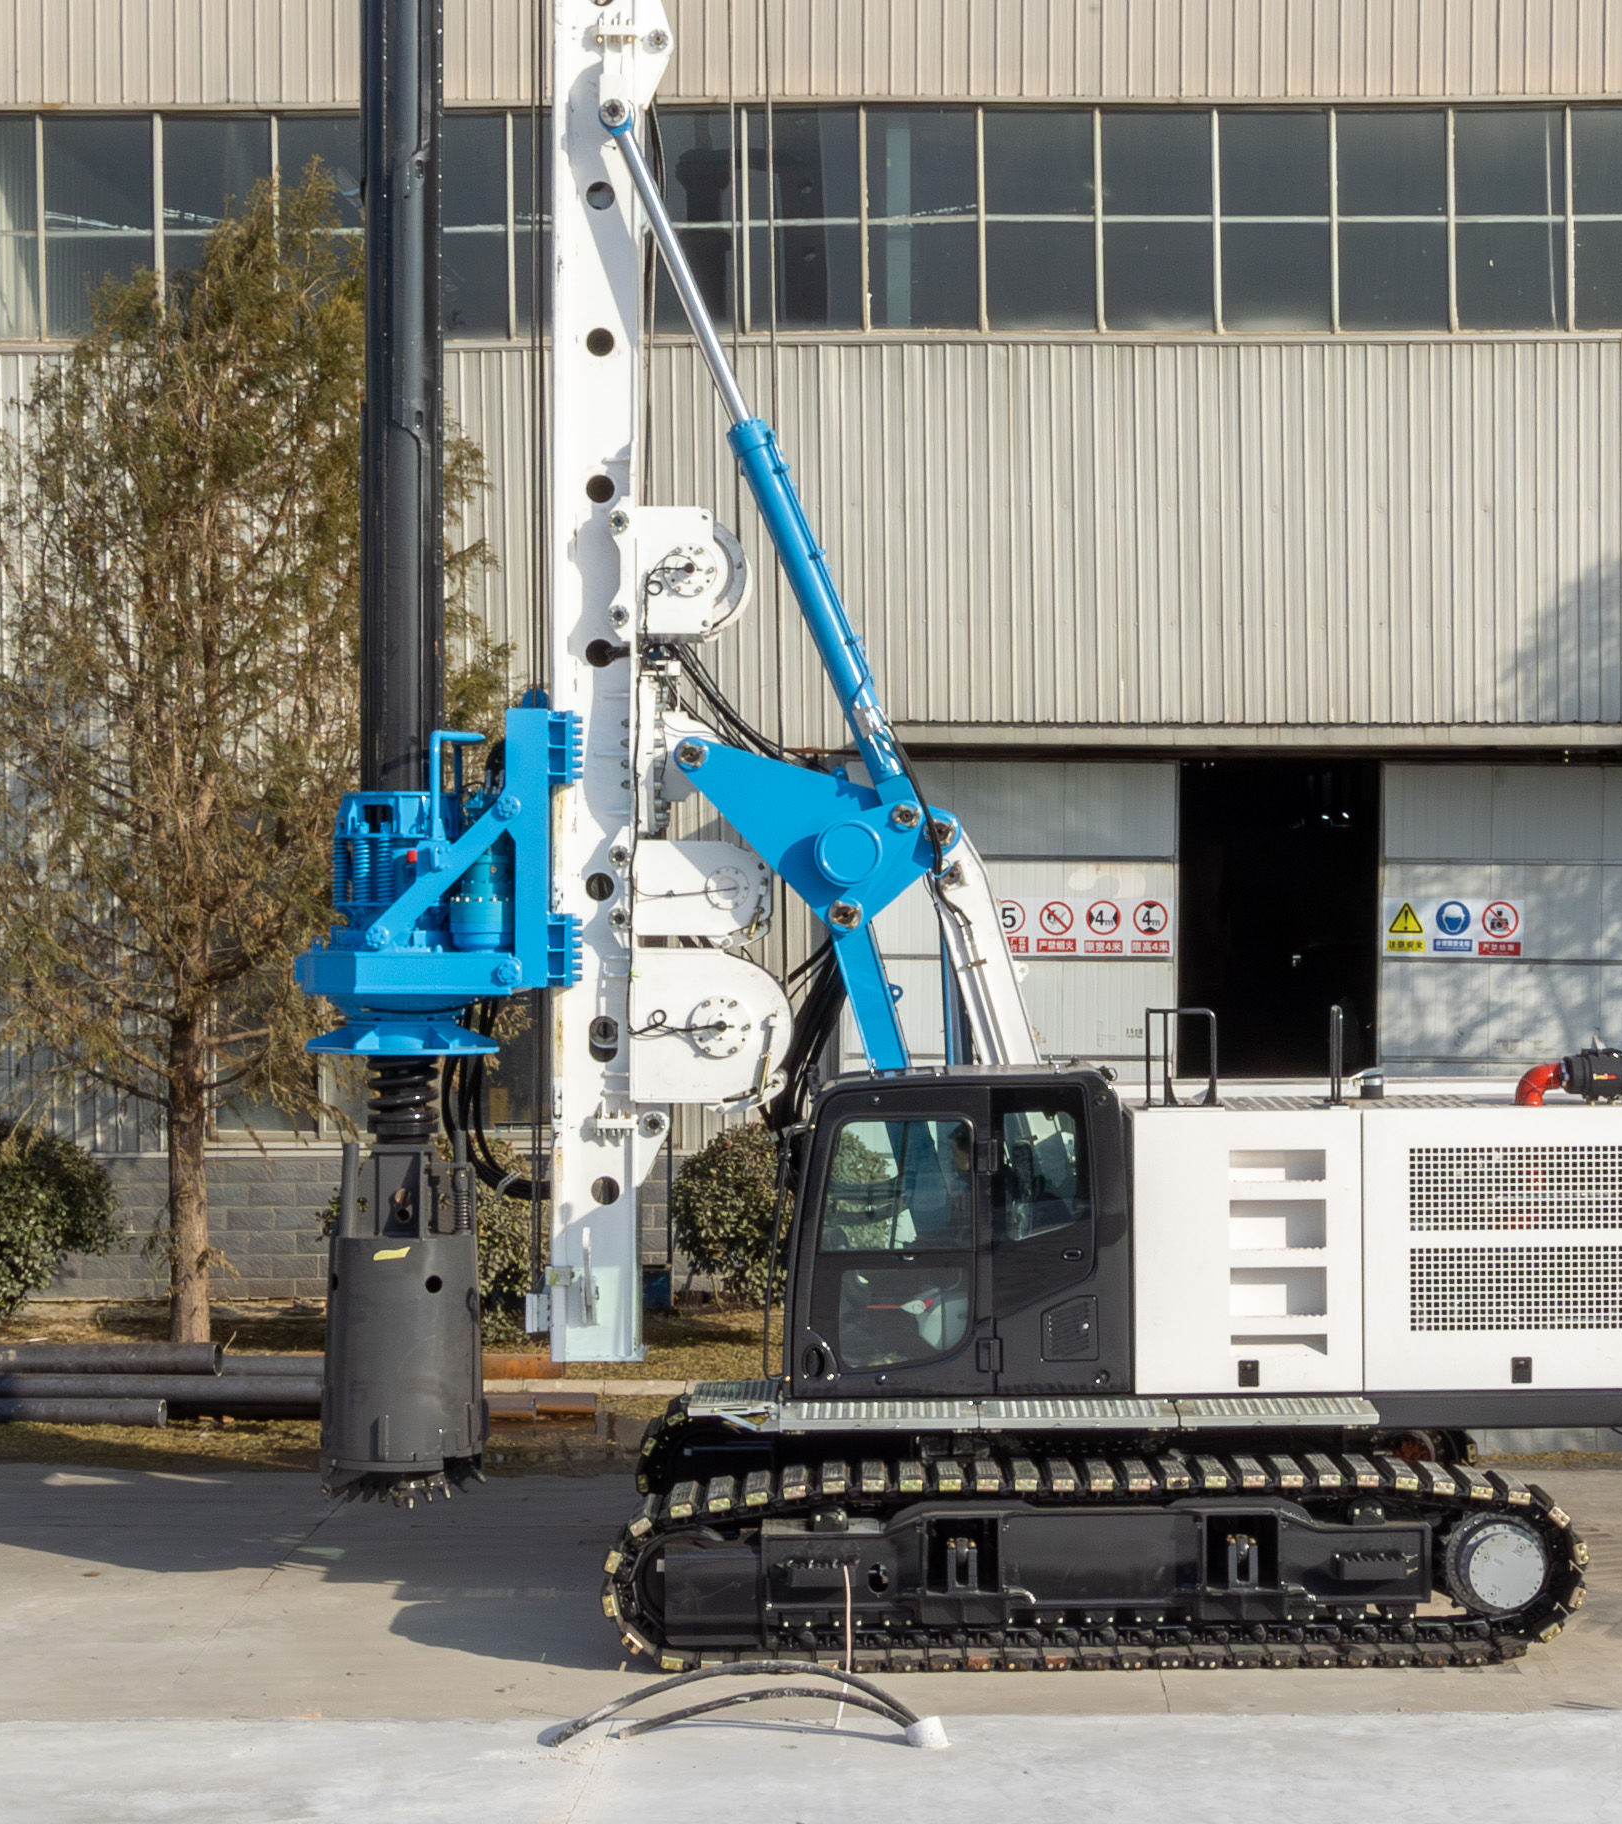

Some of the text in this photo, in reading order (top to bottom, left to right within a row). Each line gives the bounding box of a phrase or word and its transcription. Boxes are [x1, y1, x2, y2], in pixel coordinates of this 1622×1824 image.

[1001, 907, 1017, 928] 5
[1095, 909, 1114, 926] 4m
[1142, 909, 1161, 926] 4m
[1039, 940, 1074, 951] 严禁烟火
[1085, 941, 1122, 953] 限宽4米
[1132, 941, 1169, 953] 限高4米
